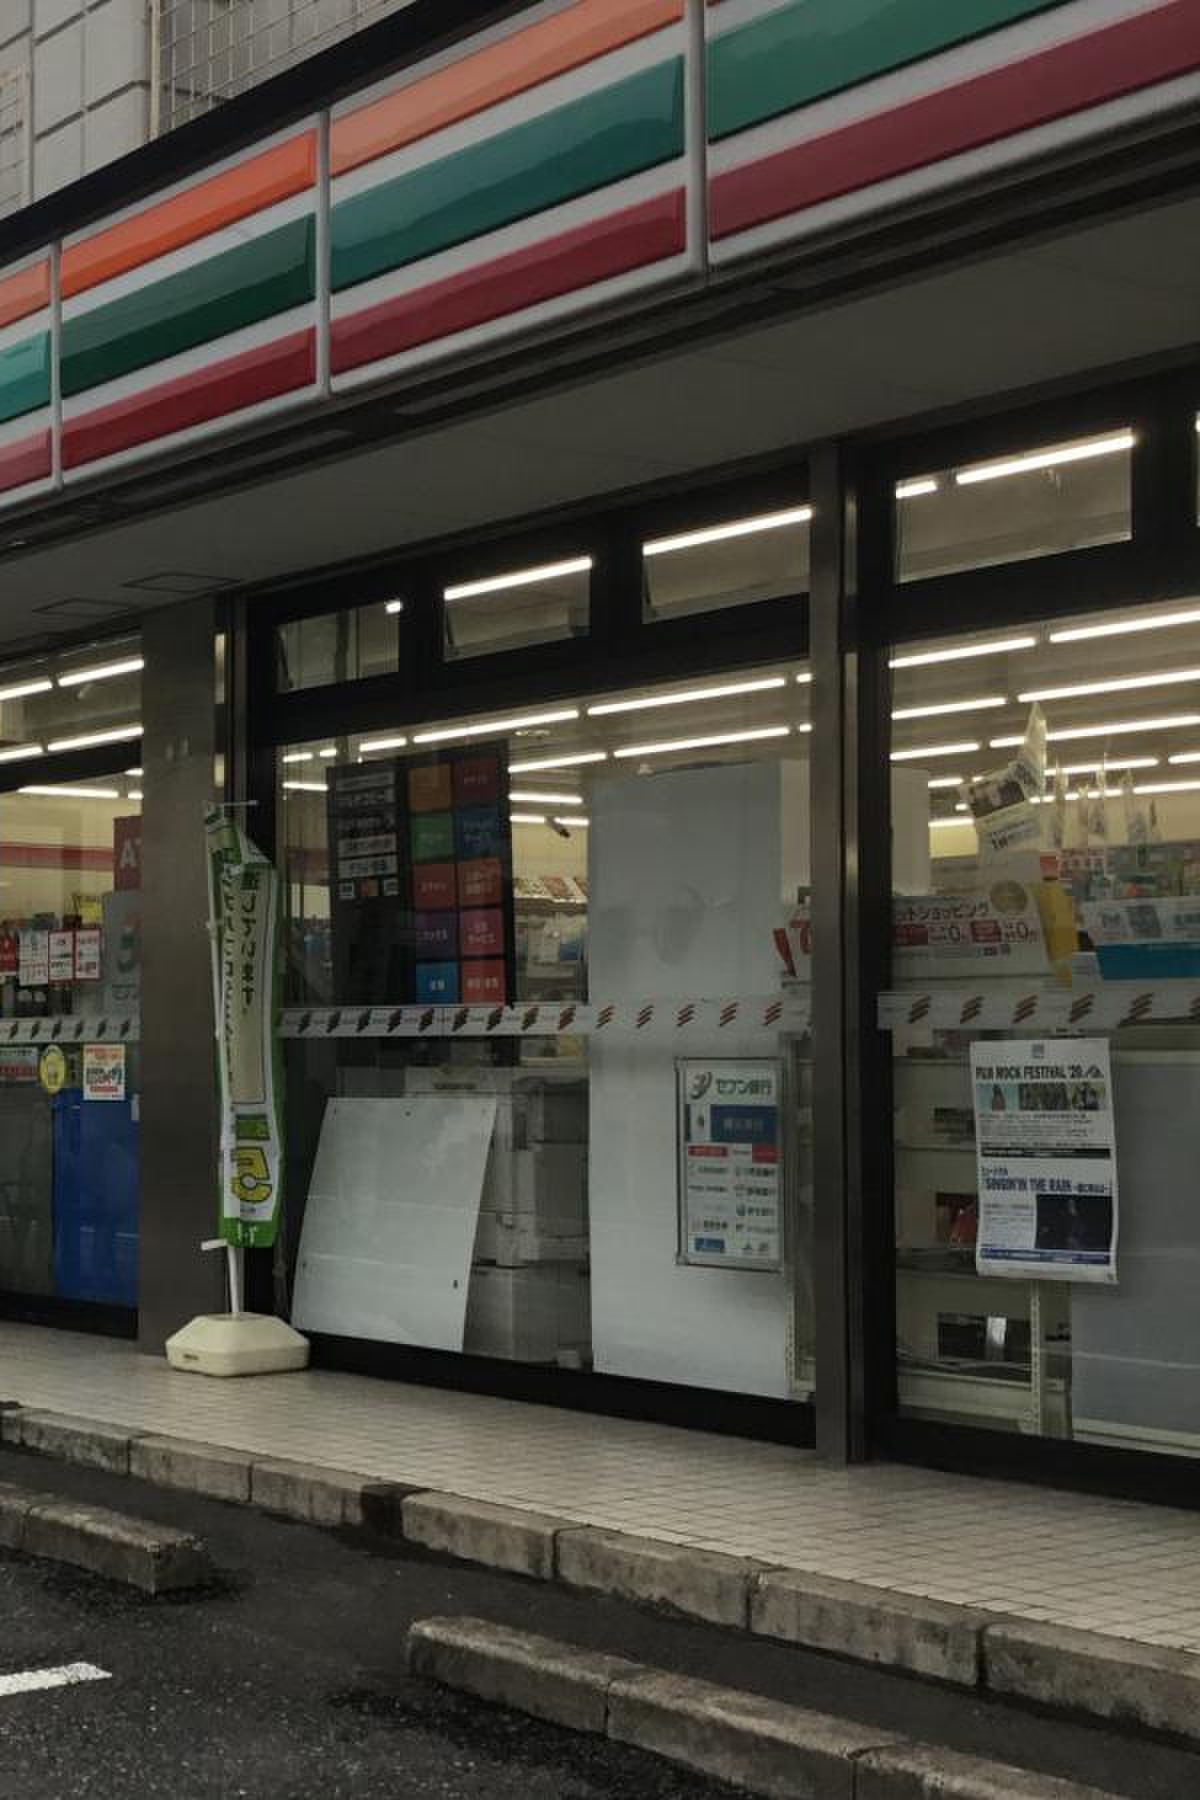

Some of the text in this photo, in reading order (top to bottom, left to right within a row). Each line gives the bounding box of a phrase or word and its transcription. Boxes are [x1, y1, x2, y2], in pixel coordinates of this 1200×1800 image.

[1024, 1065, 1066, 1080] FESTIVAL
[715, 1078, 771, 1095] セブン銀行
